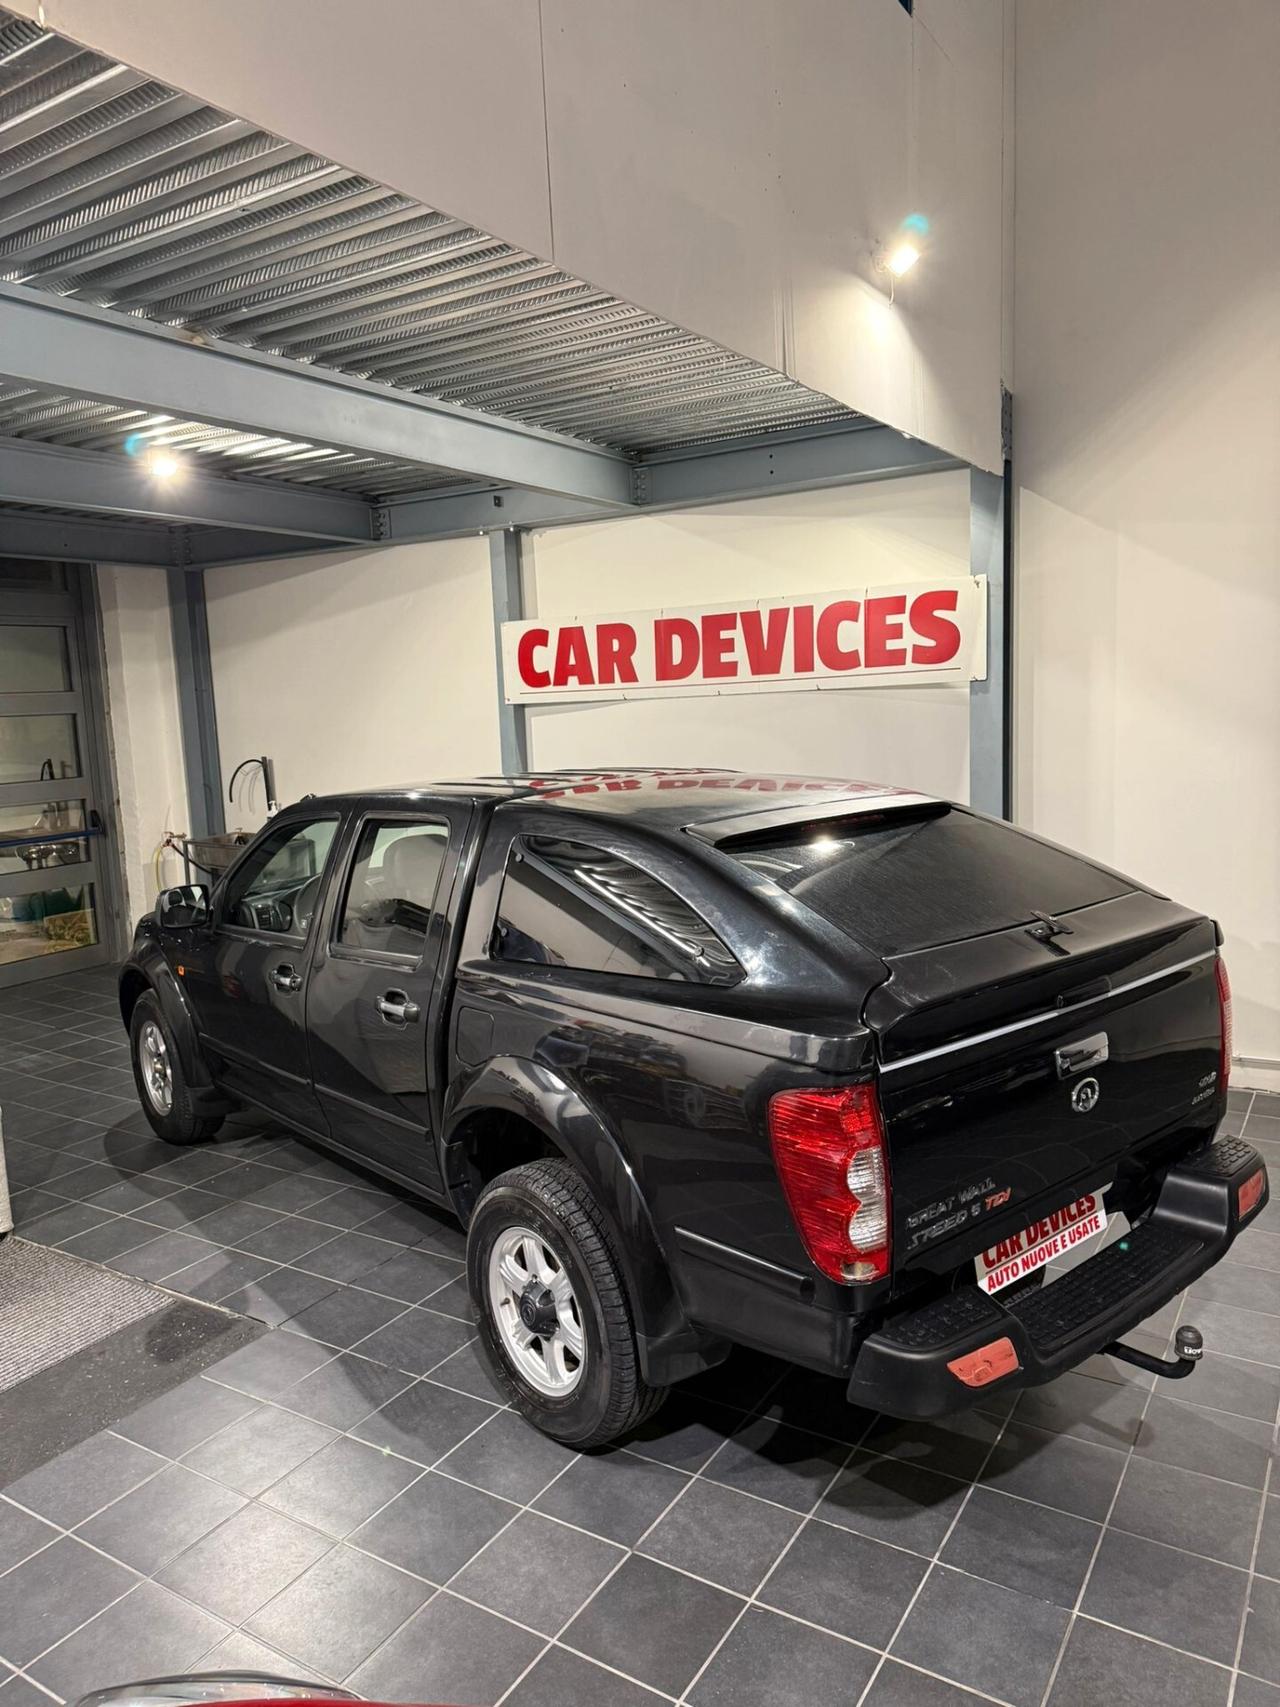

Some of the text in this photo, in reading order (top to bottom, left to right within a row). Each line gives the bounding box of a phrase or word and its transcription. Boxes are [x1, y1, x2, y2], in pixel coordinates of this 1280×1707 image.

[518, 590, 961, 688] CAR DEVICES
[906, 1209, 969, 1250] STEED
[970, 1202, 982, 1218] 5
[907, 1176, 996, 1228] GREAT WALL
[982, 1195, 1096, 1269] CAR DEVICES
[987, 1214, 1101, 1292] AUTO NUOVE E USATE
